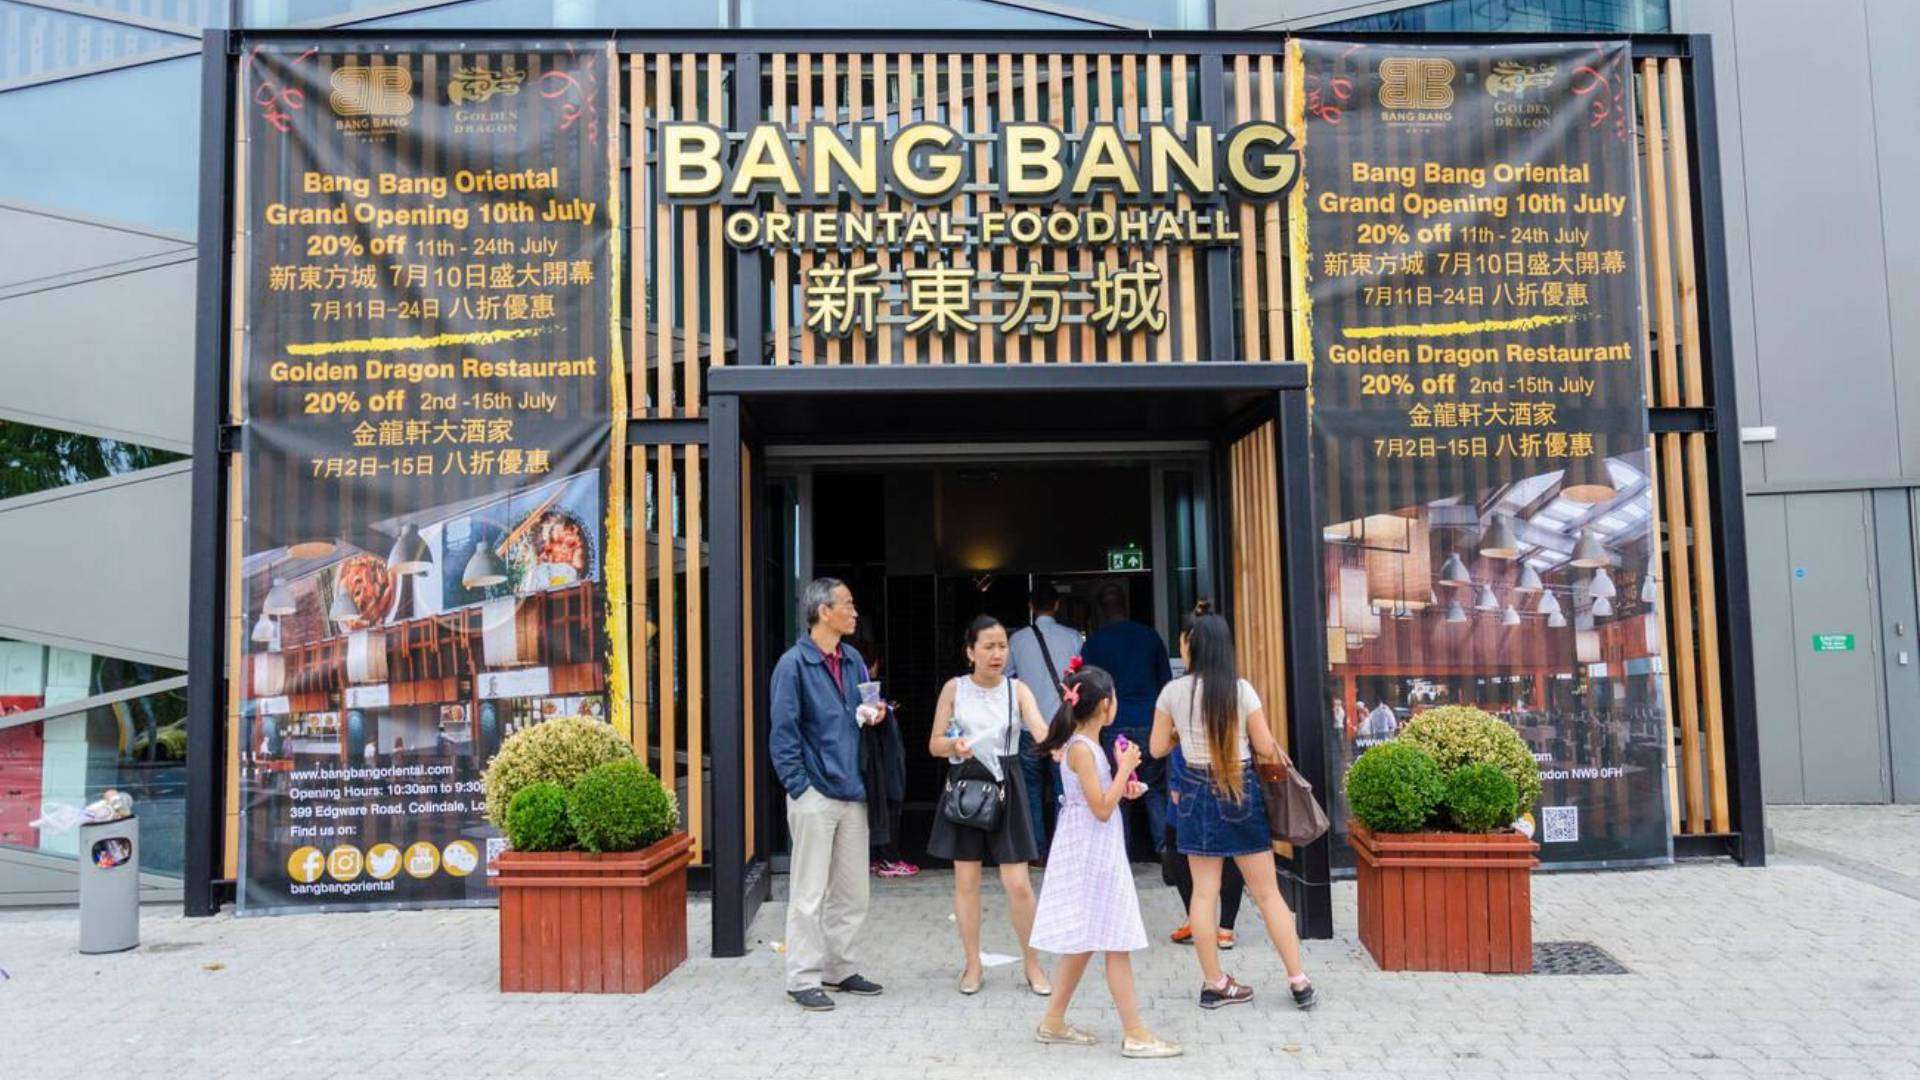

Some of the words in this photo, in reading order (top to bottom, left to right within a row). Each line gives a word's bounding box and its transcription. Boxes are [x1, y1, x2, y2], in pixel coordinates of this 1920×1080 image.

[336, 118, 369, 130] BANG
[372, 117, 409, 129] BANG
[1381, 111, 1417, 122] BANG
[1417, 111, 1452, 122] BANG
[664, 125, 963, 196] BANG
[1005, 124, 1297, 196] BANG
[304, 172, 370, 197] Bang
[379, 173, 447, 198] Bang
[455, 168, 558, 194] Oriental
[1352, 163, 1416, 187] Bang
[1424, 163, 1485, 187] Bang
[1494, 163, 1590, 183] Oriental
[266, 203, 347, 226] Grand
[354, 202, 469, 229] Opening
[480, 201, 534, 225] 10th
[542, 198, 595, 225] July
[1319, 192, 1395, 214] Grand
[1403, 192, 1508, 219] Opening
[1516, 194, 1566, 214] 10th
[1574, 193, 1626, 217] July
[726, 211, 966, 244] ORIENTAL
[982, 210, 1239, 243] FOODHALL
[1357, 224, 1410, 245] 20%
[1418, 223, 1452, 244] off
[1462, 227, 1494, 243] 11th
[1512, 227, 1549, 244] 24th
[1555, 228, 1589, 248] July
[307, 235, 364, 257] 20%
[370, 234, 407, 255] off
[416, 239, 454, 256] 11th
[473, 238, 515, 256] 24th
[520, 237, 558, 257] July
[269, 265, 377, 291] 新東方城
[390, 261, 594, 289] 7月10日盛大開幕
[1324, 252, 1424, 276] 新東方城
[1437, 251, 1626, 276] 7月10日盛大開幕
[806, 261, 1166, 334] 新東方城
[1492, 282, 1590, 306] 八折優惠
[449, 294, 555, 320] 八折優惠
[1329, 344, 1410, 364] Golden
[1418, 344, 1498, 367] Dragon
[1506, 342, 1631, 362] Restaurant
[270, 361, 358, 382] Golden
[366, 360, 455, 383] Dragon
[463, 357, 597, 379] Restaurant
[1362, 374, 1414, 395] 20%
[1422, 373, 1455, 394] off
[1470, 377, 1503, 393] 2nd
[1559, 377, 1594, 397] July
[304, 392, 360, 414] 20%
[369, 390, 405, 413] off
[420, 392, 456, 410] 2nd
[518, 391, 557, 413] July
[1409, 402, 1556, 427] 金龍軒大酒家
[352, 418, 514, 447] 金龍軒大酒家
[1495, 433, 1594, 457] 八折優惠
[441, 448, 550, 476] 八折優惠
[290, 764, 453, 780] www.bangbangoriental.com
[1536, 769, 1569, 780] ndon
[1572, 767, 1599, 779] NW9
[289, 787, 340, 801] Opening
[344, 785, 383, 797] Hours:
[388, 783, 437, 795] 10:30am
[440, 783, 452, 794] to
[455, 781, 486, 794] 9:30p
[290, 806, 312, 818] 399
[315, 804, 366, 818] Edgware
[371, 803, 405, 816] Road,
[409, 800, 467, 814] Colindale,
[290, 825, 317, 837] Find
[320, 827, 334, 836] us
[337, 826, 357, 835] on:
[291, 879, 394, 895] bangbangoriental
